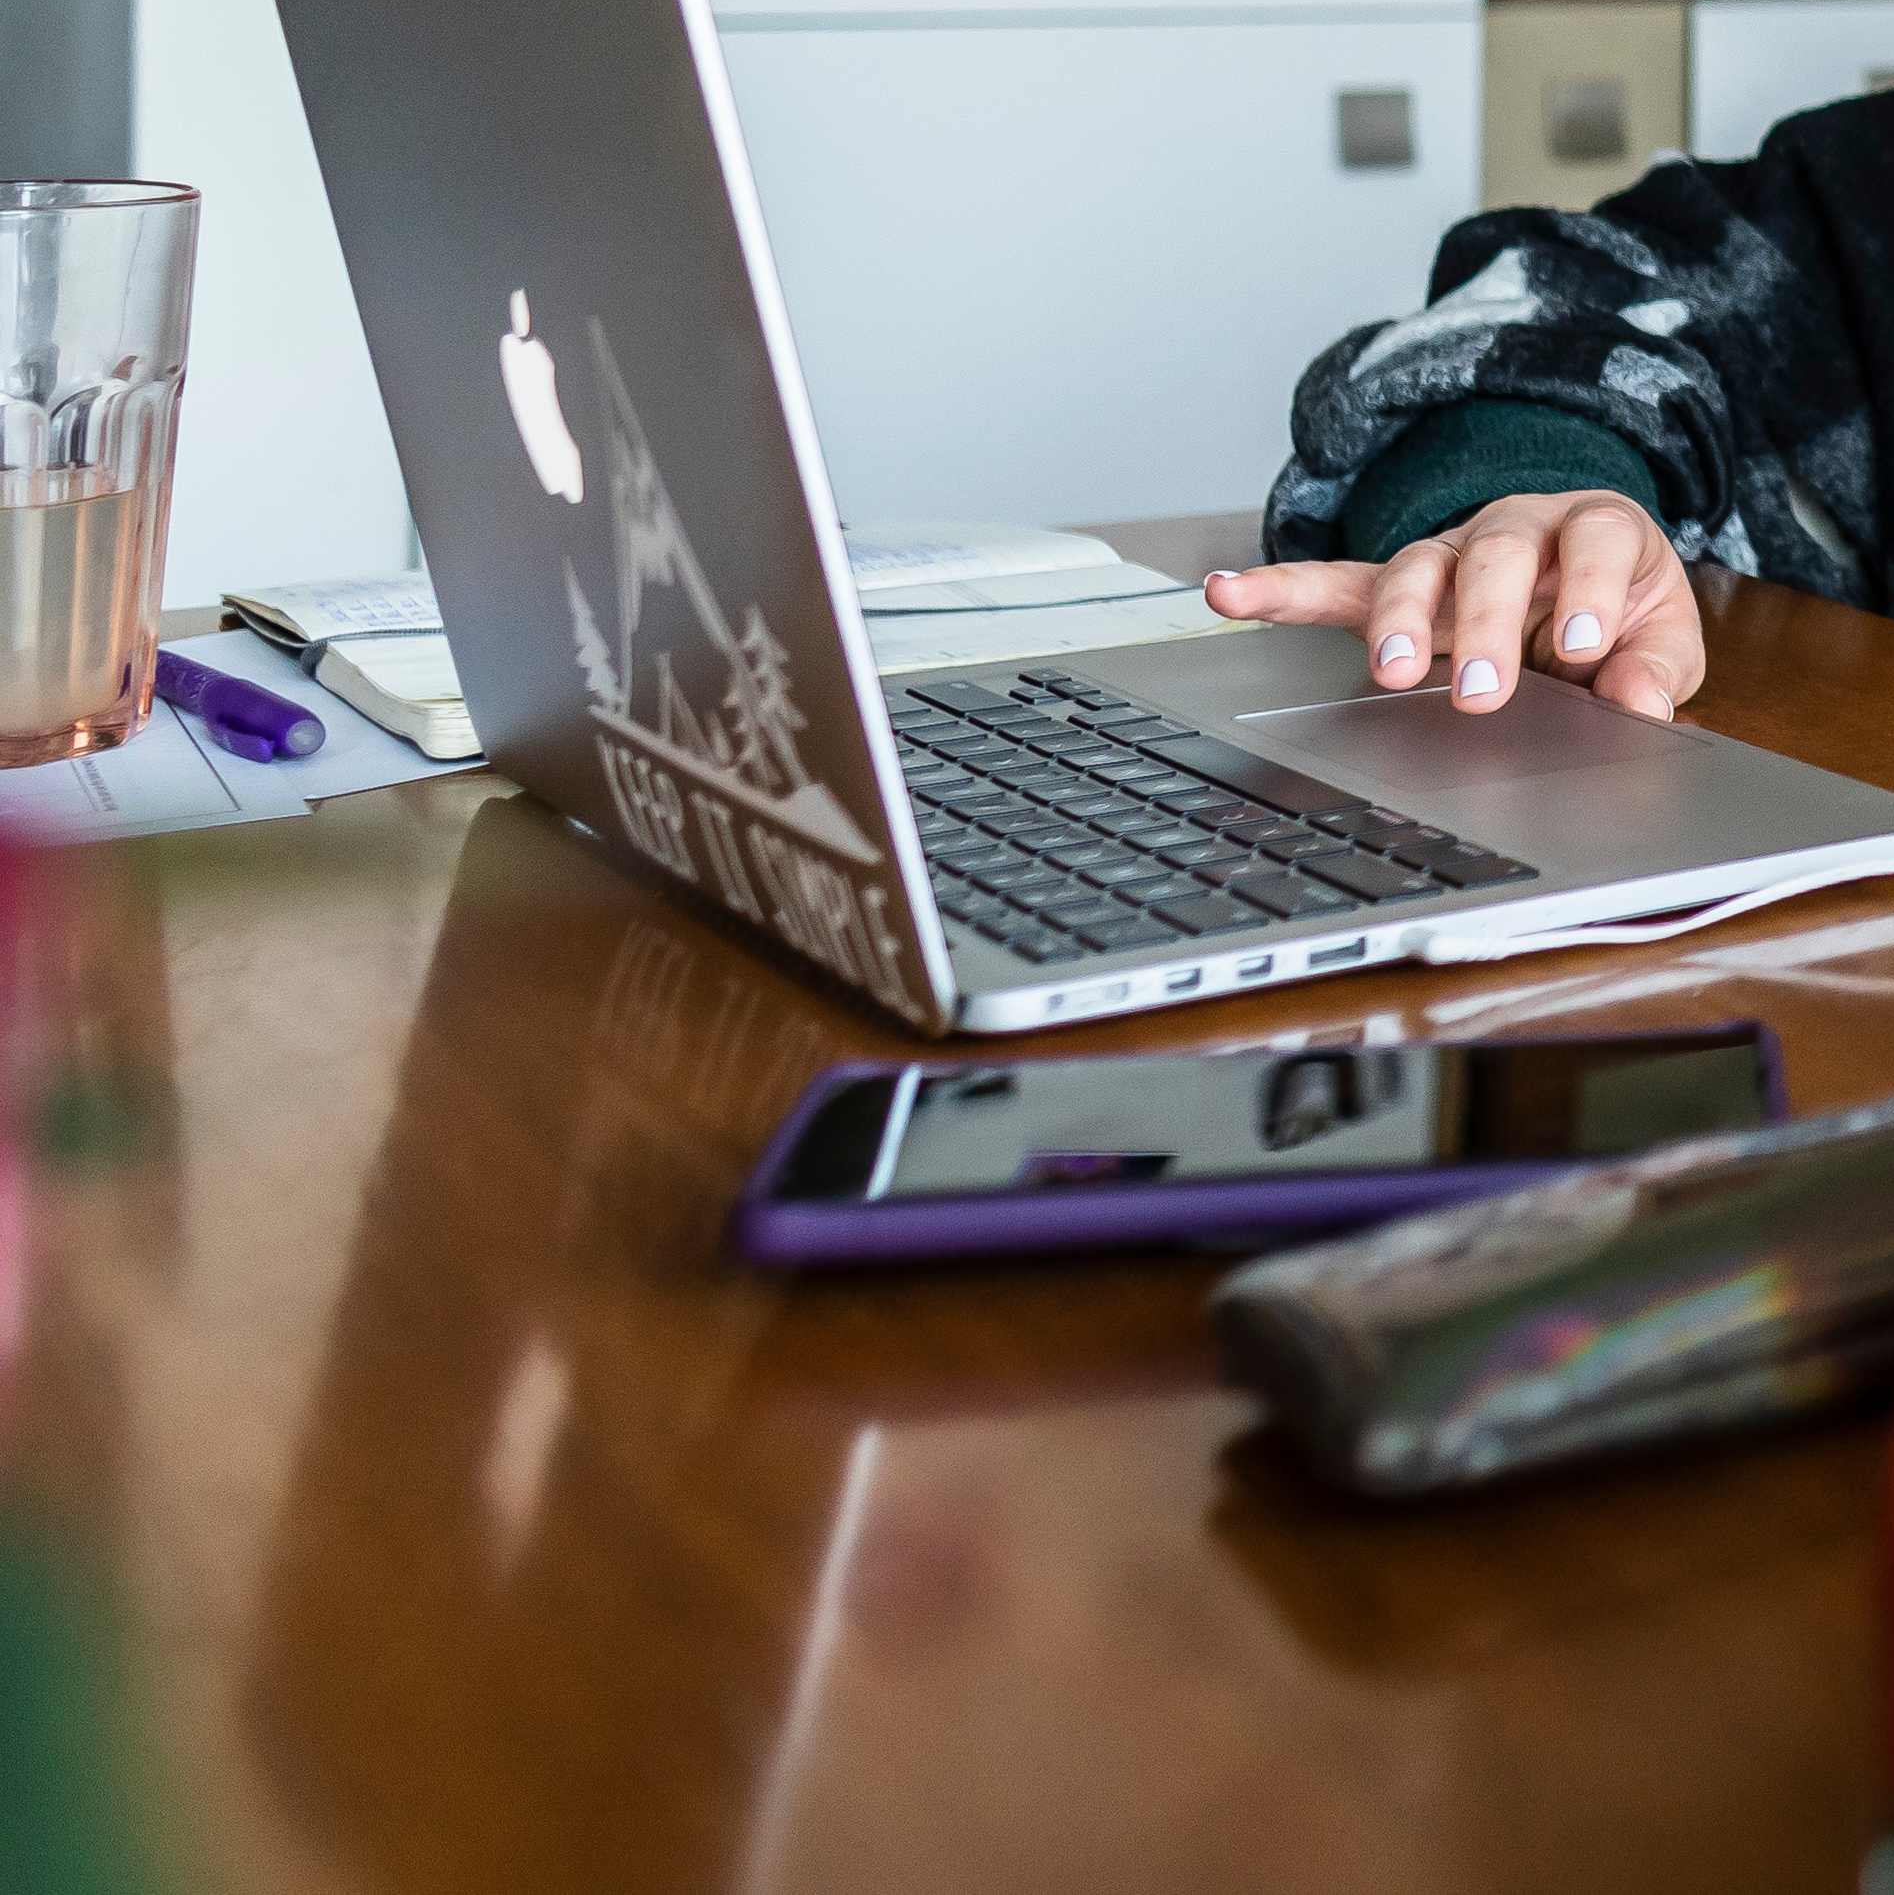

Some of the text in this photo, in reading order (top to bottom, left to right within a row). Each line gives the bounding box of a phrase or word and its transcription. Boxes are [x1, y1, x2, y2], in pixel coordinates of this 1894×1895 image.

[596, 734, 929, 1025] KEEP IT SIMPLE
